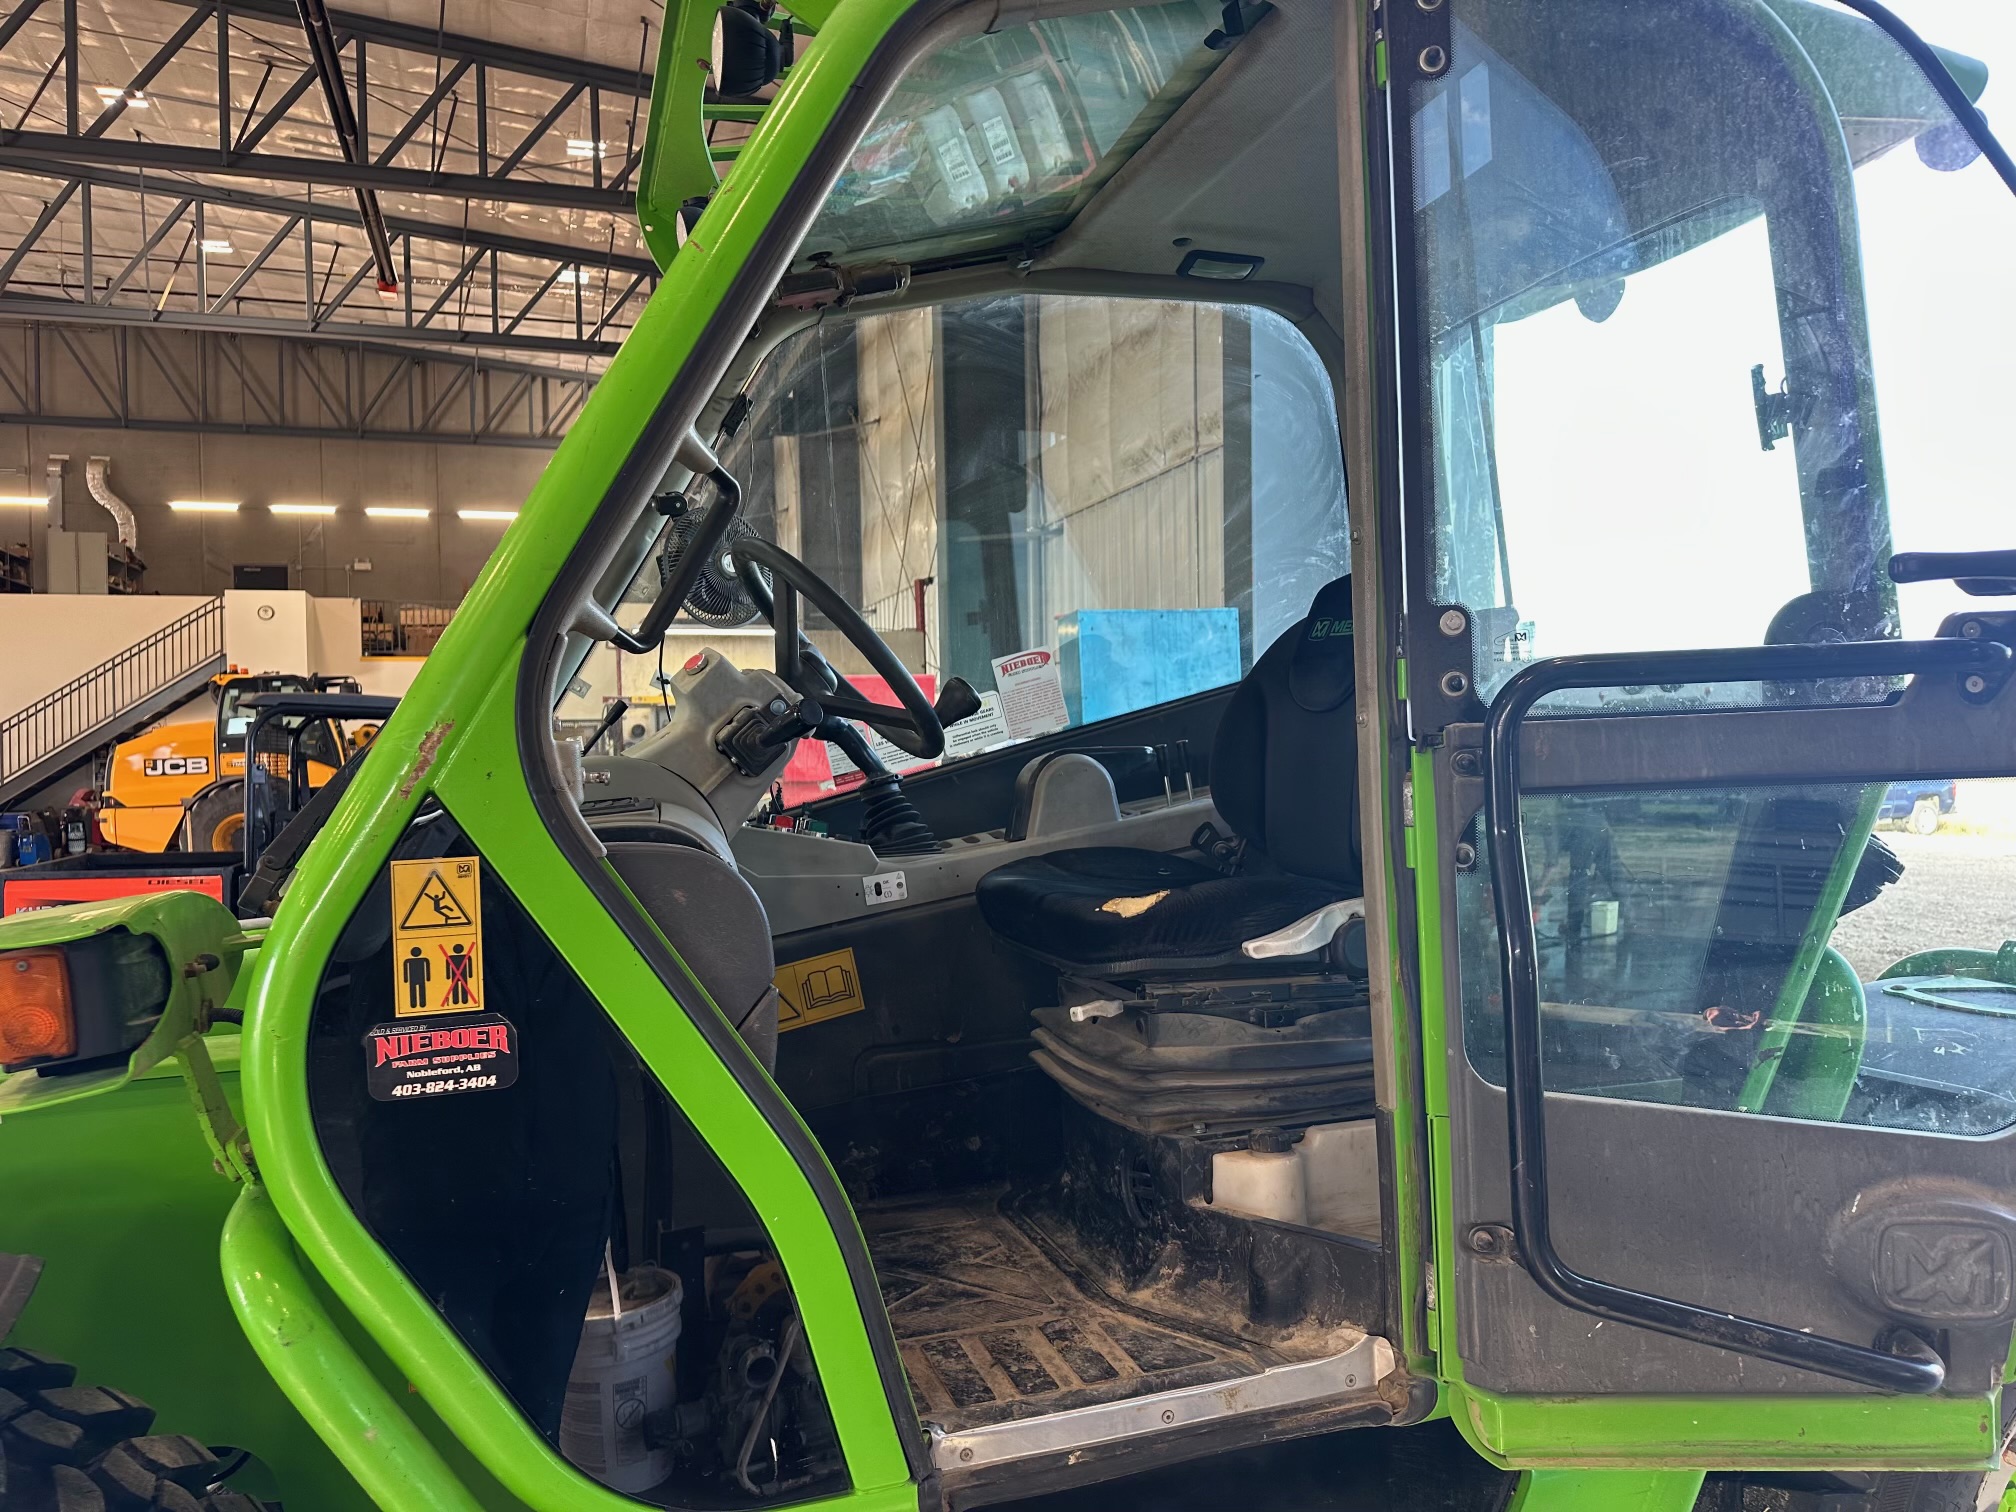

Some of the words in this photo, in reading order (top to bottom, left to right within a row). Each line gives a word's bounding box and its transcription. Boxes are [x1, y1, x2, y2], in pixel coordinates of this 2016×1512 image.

[144, 757, 208, 776] JCB
[374, 1024, 511, 1068] NIEBOER
[392, 1057, 429, 1068] FARM
[432, 1050, 497, 1064] SUPPLIES
[406, 1066, 464, 1079] Nobleford,
[465, 1064, 482, 1073] AB
[391, 1074, 497, 1097] 403-824-3404
